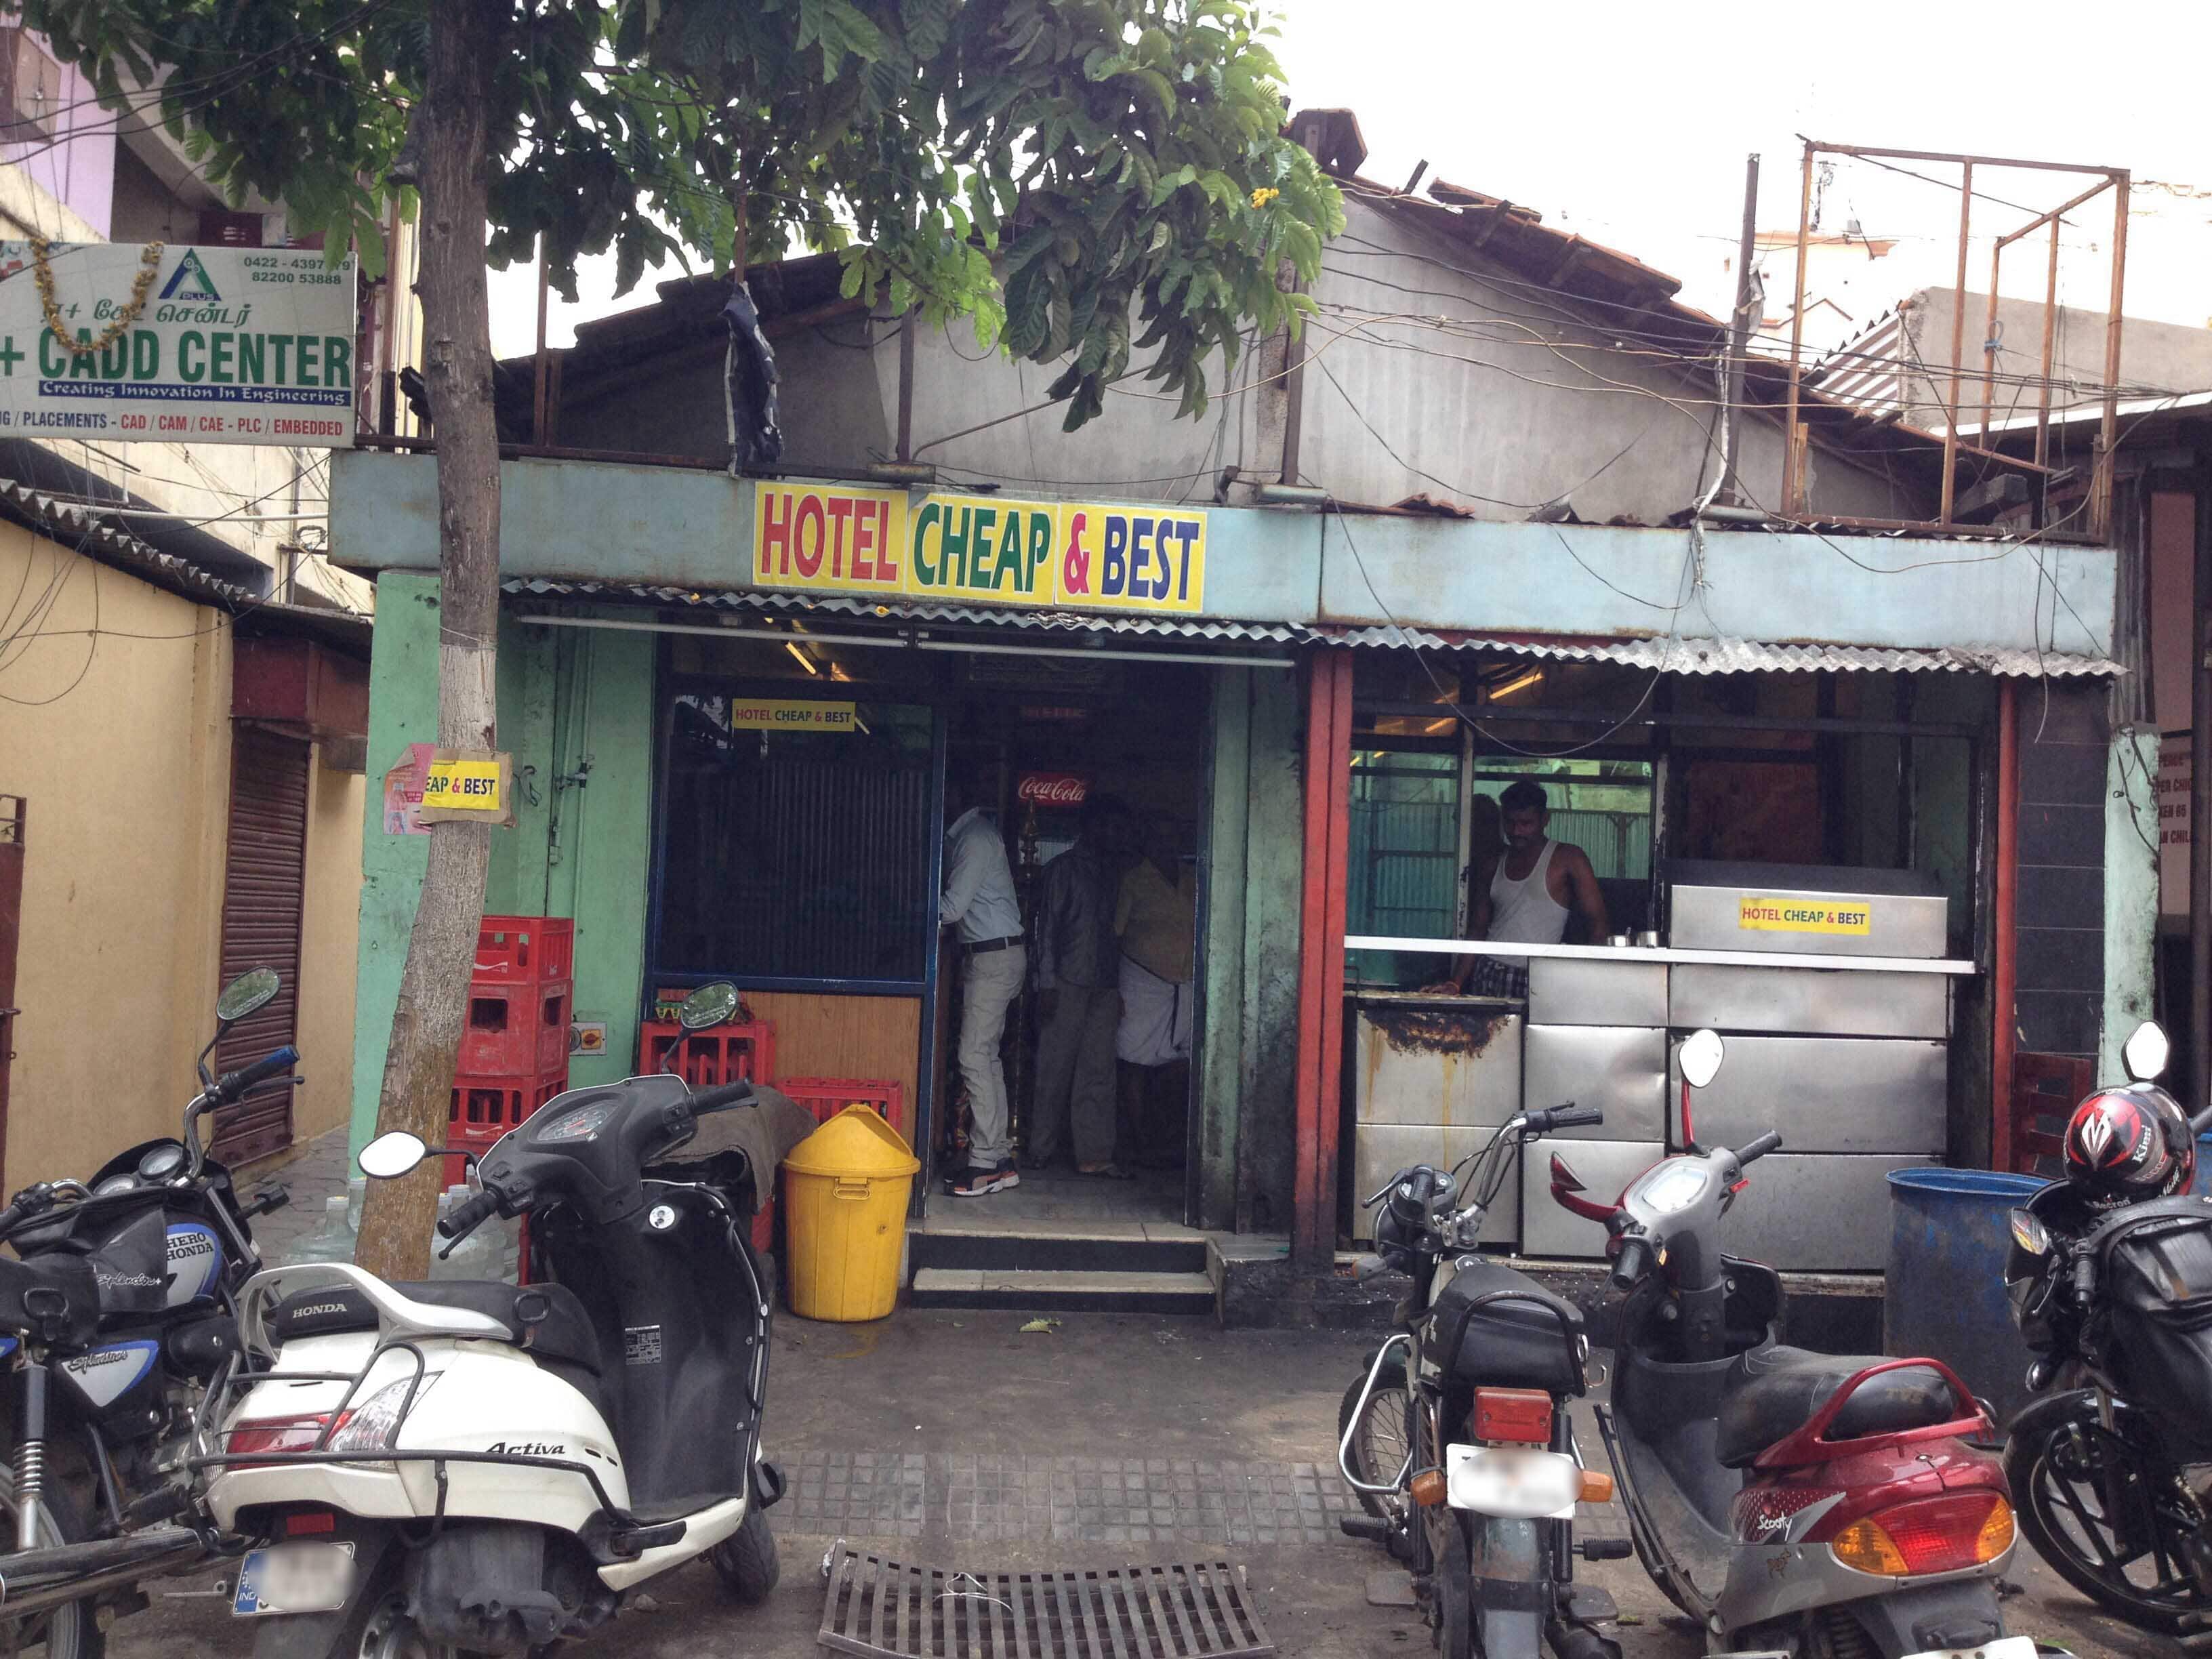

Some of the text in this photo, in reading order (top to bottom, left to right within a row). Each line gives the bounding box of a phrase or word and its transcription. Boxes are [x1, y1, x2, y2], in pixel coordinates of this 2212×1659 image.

[244, 257, 277, 268] 0422
[252, 272, 342, 285] 82200 53888
[39, 327, 159, 380] CADD
[178, 330, 351, 388] CENTER
[43, 381, 345, 405] Creating Innovation In Engineering
[0, 411, 11, 426] G
[23, 411, 107, 428] PLACEMENTS
[121, 414, 146, 430] CAD
[159, 415, 186, 431] CAM
[199, 417, 224, 432] CAE
[238, 418, 261, 433] PLC
[274, 419, 342, 436] EMBEDDED
[761, 493, 1200, 601] HOTEL CHEAP & BEST
[736, 709, 852, 723] HOTEL CHEAP & BEST
[452, 777, 460, 794] &
[464, 777, 495, 795] BEST
[1742, 907, 1866, 925] HOTEL CHEAP & BEST
[167, 1232, 206, 1249] HERO
[166, 1242, 213, 1261] HONDA
[292, 1303, 348, 1319] HONDA
[486, 1441, 566, 1455] Activa
[1757, 1510, 1793, 1542] Scooty
[239, 1591, 256, 1601] IND
